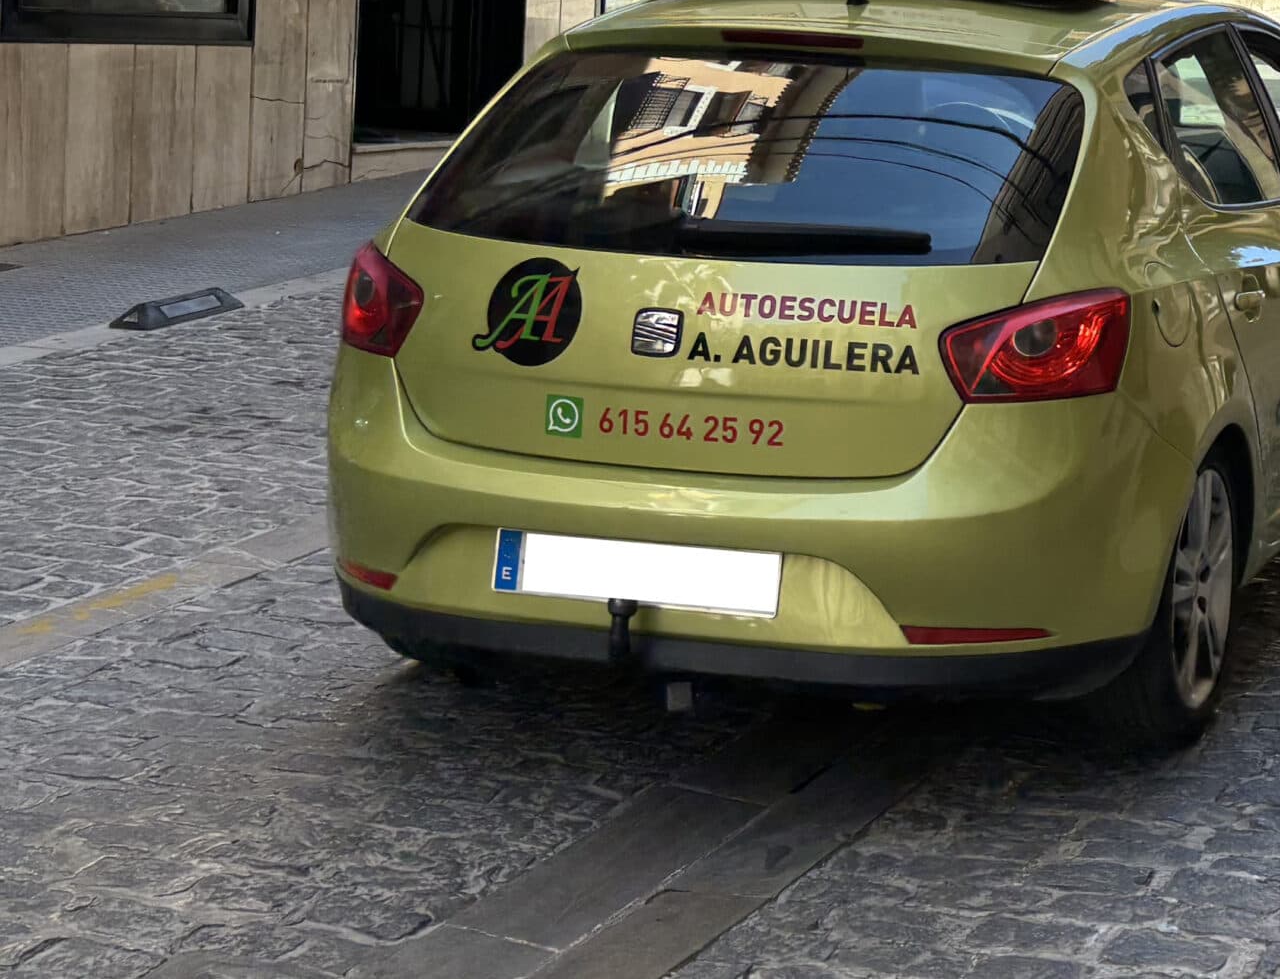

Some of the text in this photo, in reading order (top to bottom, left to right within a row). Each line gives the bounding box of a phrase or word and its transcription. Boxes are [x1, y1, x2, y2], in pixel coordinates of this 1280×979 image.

[696, 291, 918, 329] AUTOESCUELA
[687, 332, 920, 375] A. AGUILERA
[599, 407, 785, 447] 615 64 25 92
[501, 566, 513, 581] E
